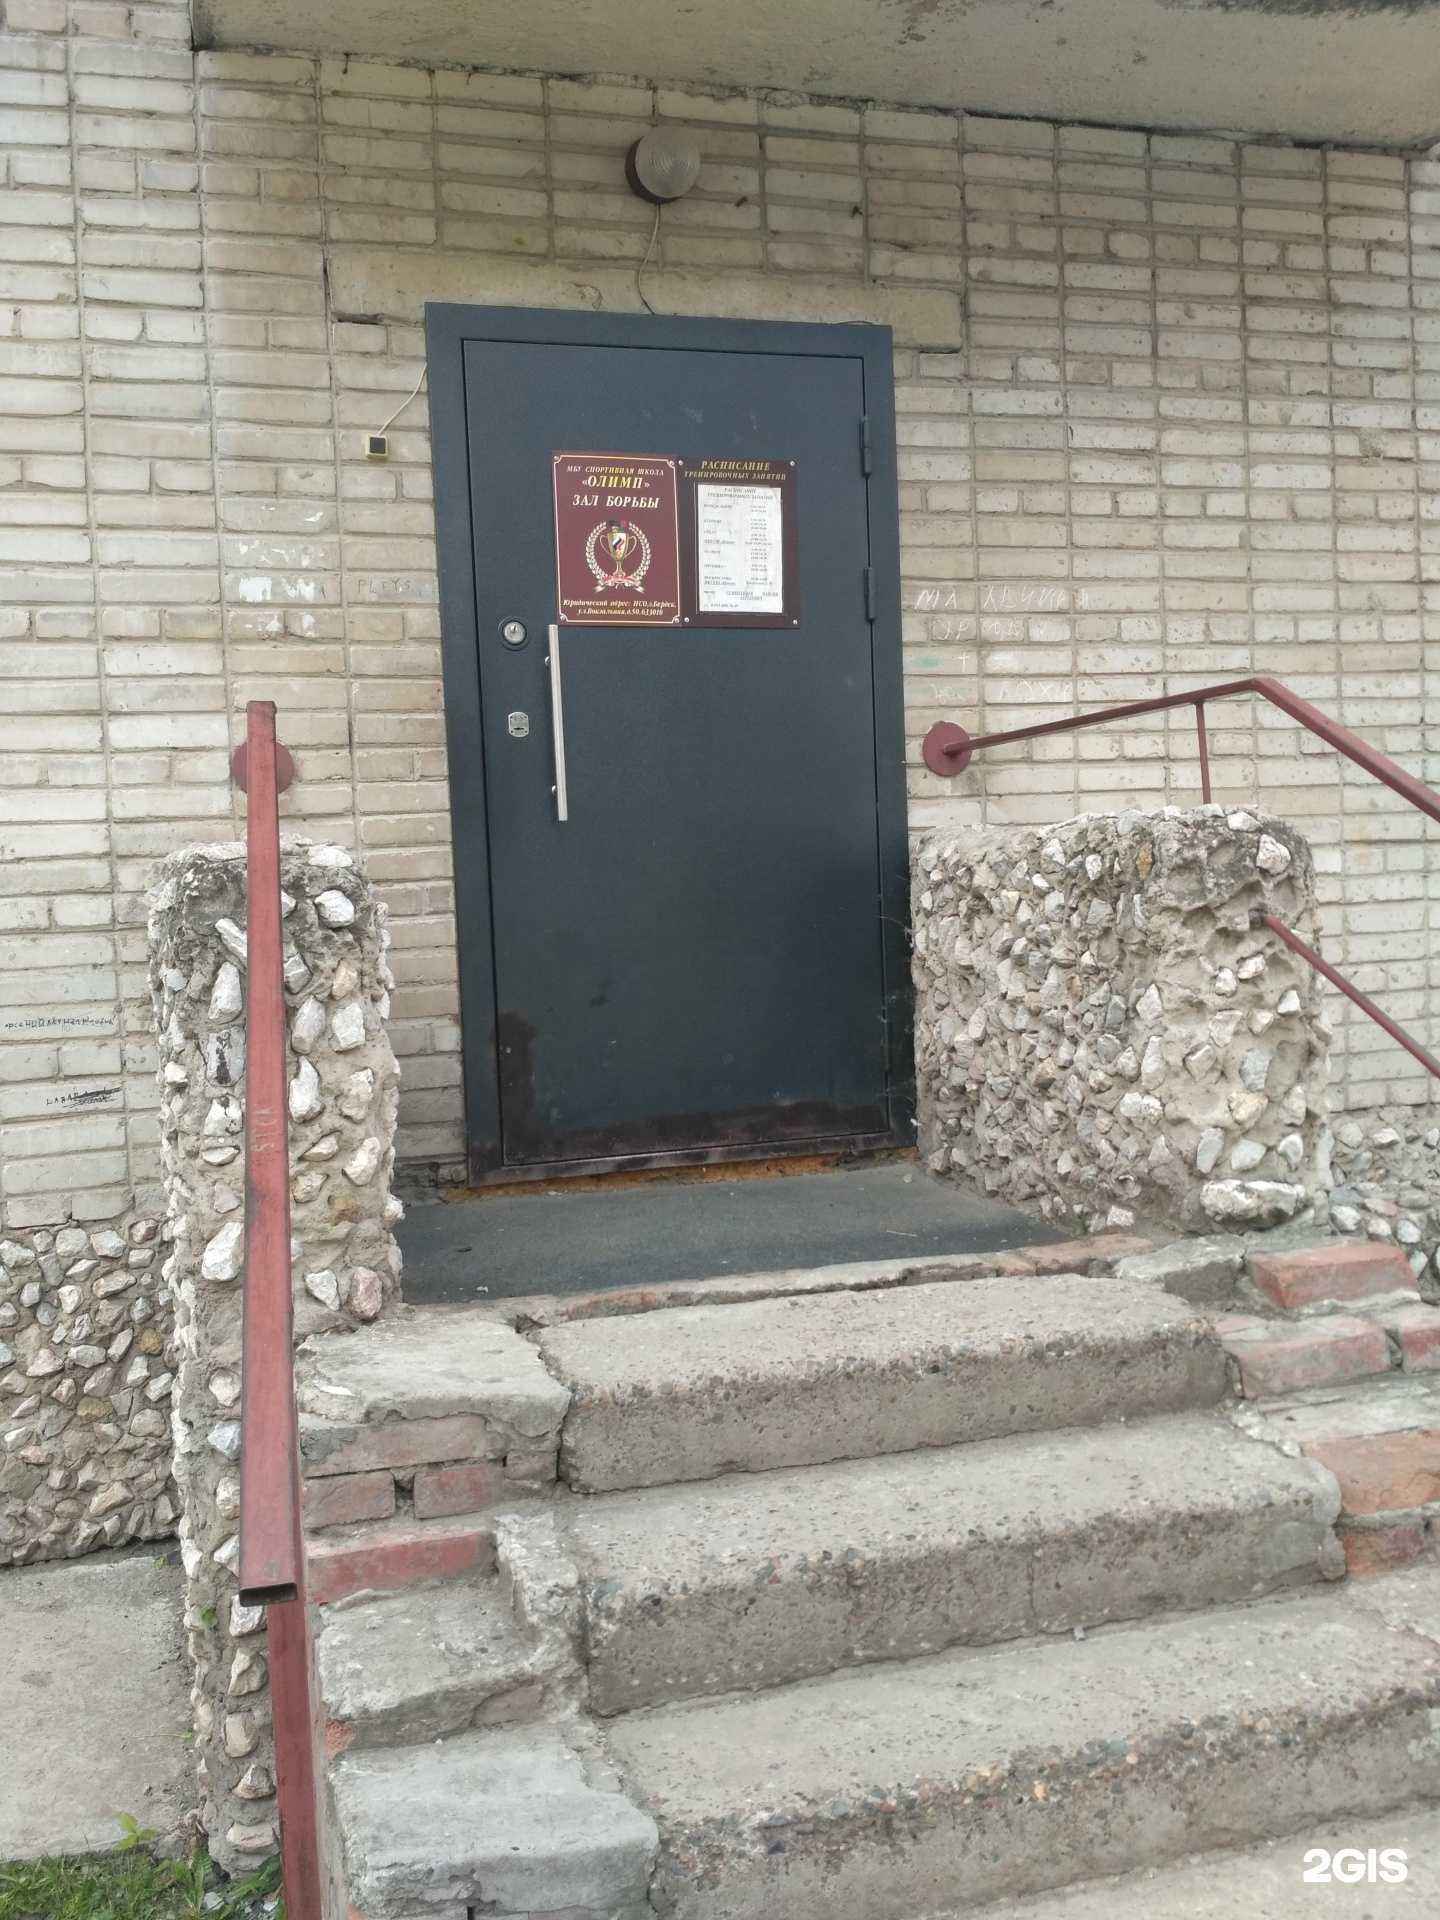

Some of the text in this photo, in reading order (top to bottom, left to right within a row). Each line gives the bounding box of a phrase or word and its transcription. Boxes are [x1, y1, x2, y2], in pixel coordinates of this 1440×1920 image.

[566, 465, 664, 476] МБУ СПОРТИВНАЯ ШКОЛА
[701, 460, 770, 471] РАСПИСАНИЕ
[684, 470, 749, 480] ТРЕНИРОВОЧНЫХ
[582, 475, 650, 489] «ОЛИМП»
[572, 494, 660, 509] ЗАЛ БОРЬБЫ
